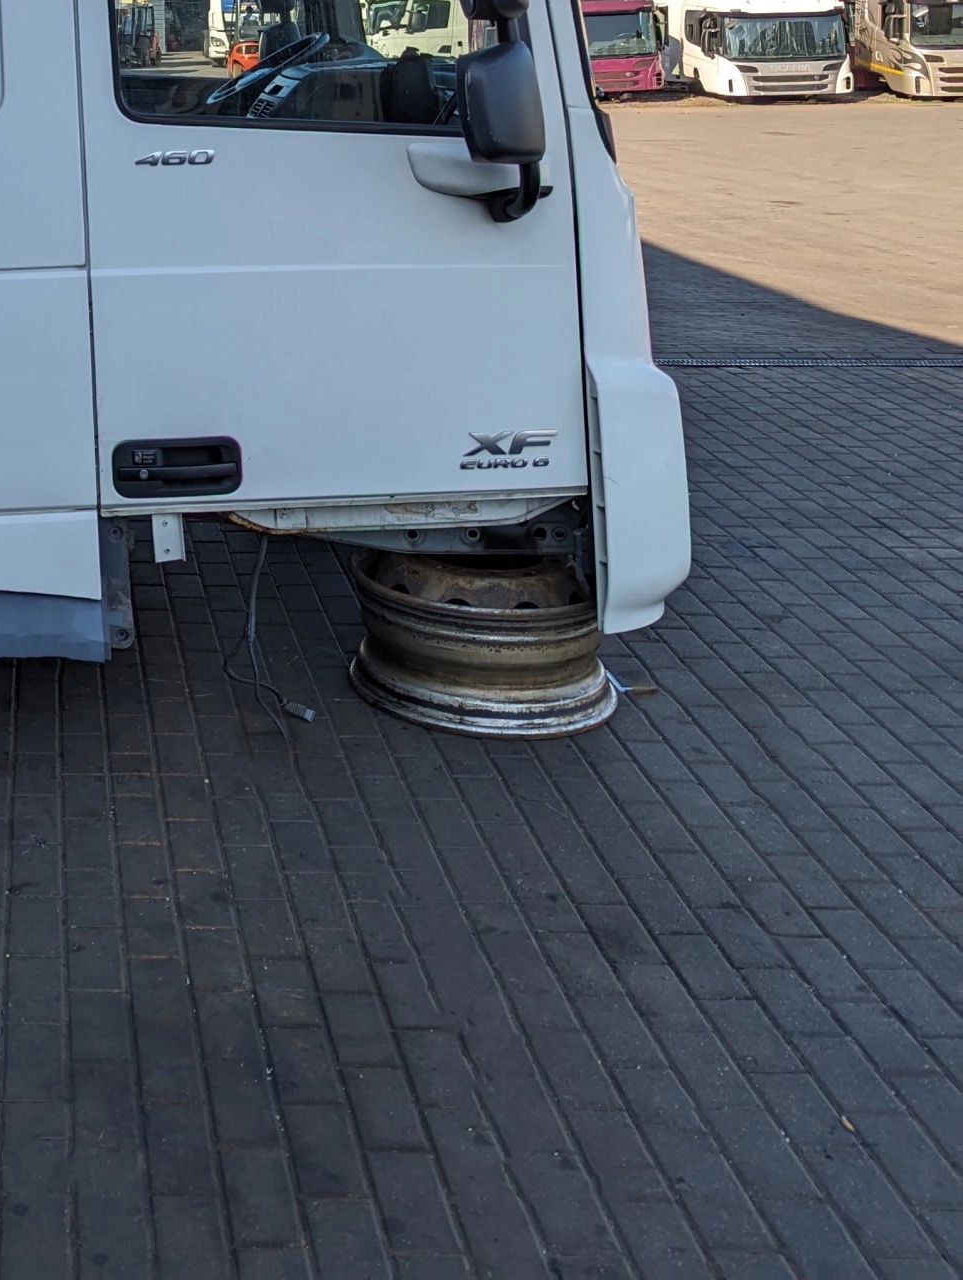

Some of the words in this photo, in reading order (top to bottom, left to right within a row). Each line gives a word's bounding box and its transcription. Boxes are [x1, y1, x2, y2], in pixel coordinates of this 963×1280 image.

[770, 64, 812, 73] SCANIA
[134, 149, 215, 166] 460
[462, 428, 558, 457] XF
[459, 457, 529, 470] EURO
[532, 455, 550, 468] 6
